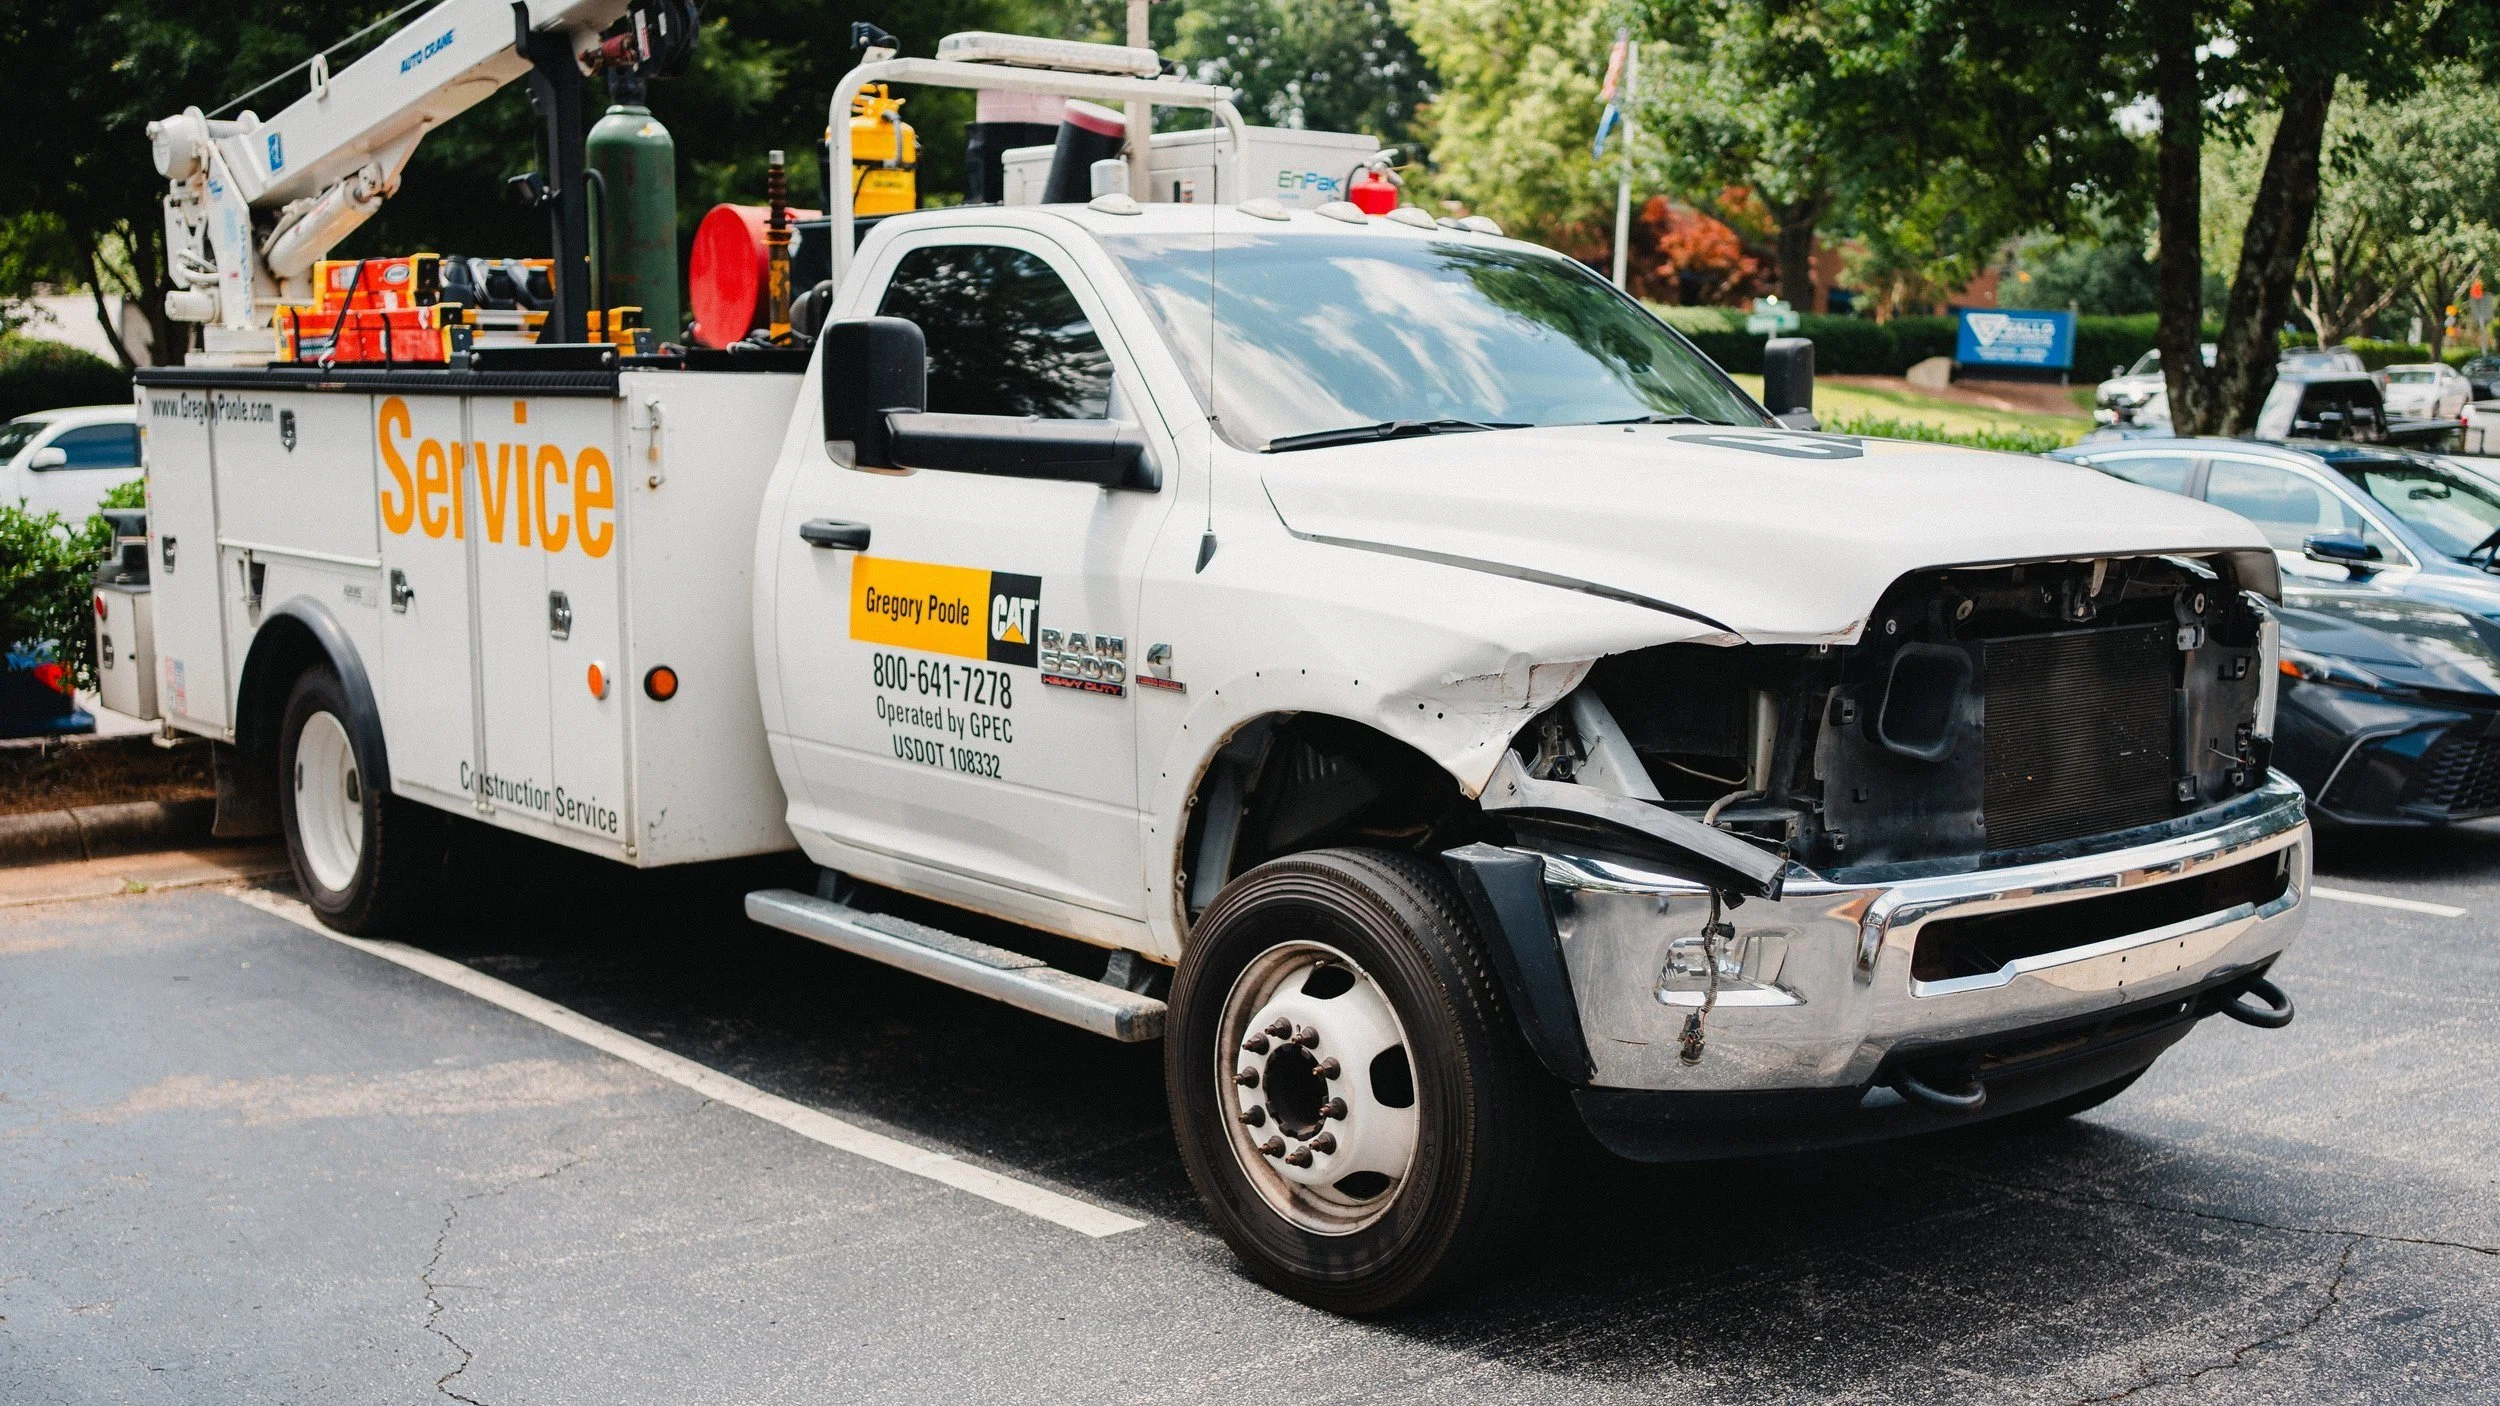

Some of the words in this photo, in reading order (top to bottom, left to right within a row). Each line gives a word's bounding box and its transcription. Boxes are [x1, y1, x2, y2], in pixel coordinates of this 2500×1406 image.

[400, 50, 422, 73] AUTO
[1279, 170, 1343, 192] EnPak
[379, 396, 614, 558] Service
[866, 586, 923, 625] Gregory
[928, 595, 970, 626] Poole
[991, 594, 1035, 645] CAT
[1041, 628, 1126, 659] RAM
[873, 652, 1012, 710] 800-641-7278
[1041, 649, 1126, 683] 5500
[1042, 675, 1084, 689] HEAVY
[1084, 681, 1120, 695] DUTY
[877, 695, 943, 728] Operated
[947, 707, 966, 740] by
[970, 711, 1013, 744] GPEC
[893, 733, 945, 767] USDOT
[950, 746, 1002, 779] 108332
[556, 787, 617, 834] Service
